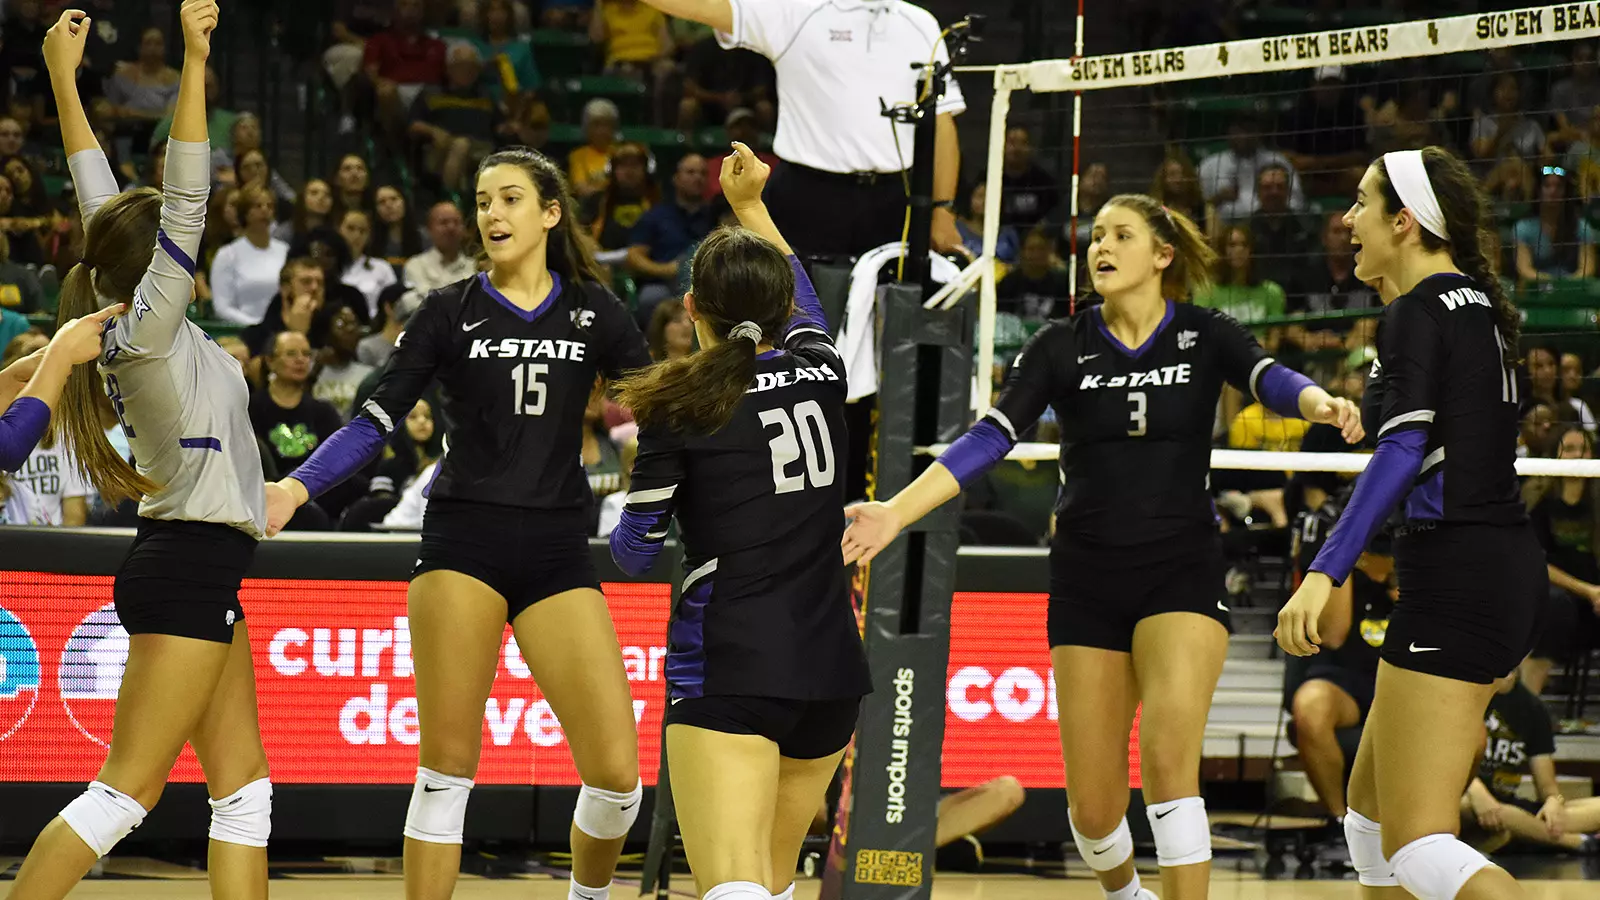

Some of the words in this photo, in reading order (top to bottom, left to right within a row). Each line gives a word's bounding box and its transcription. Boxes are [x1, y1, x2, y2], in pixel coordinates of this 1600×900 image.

[1553, 2, 1600, 32] BEA
[1328, 28, 1389, 56] BEARS
[1132, 50, 1185, 76] BEARS
[469, 338, 586, 362] K-STATE
[511, 363, 549, 416] 15
[1079, 363, 1191, 390] K-STATE
[1127, 391, 1147, 437] 3
[757, 399, 835, 495] 20
[892, 667, 915, 738] sports
[885, 739, 909, 824] imports
[858, 867, 920, 884] BEARS
